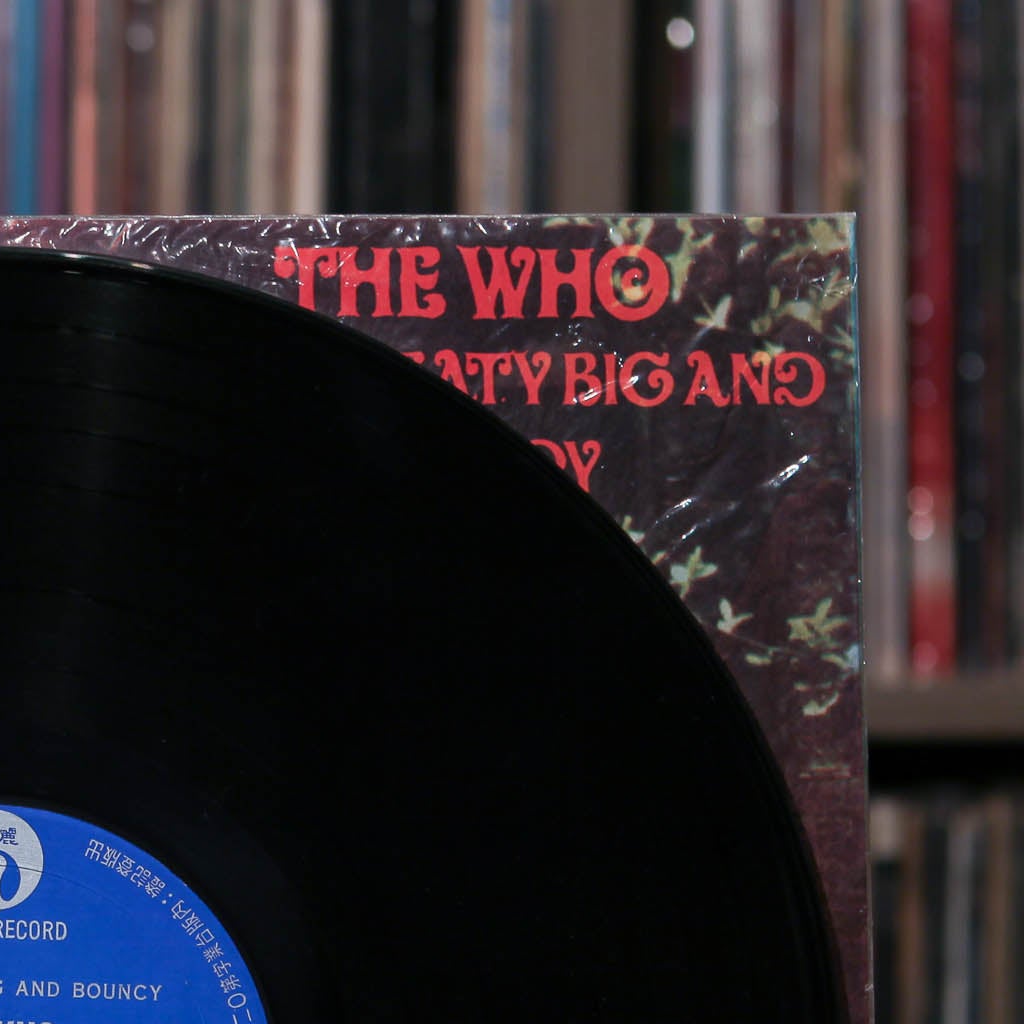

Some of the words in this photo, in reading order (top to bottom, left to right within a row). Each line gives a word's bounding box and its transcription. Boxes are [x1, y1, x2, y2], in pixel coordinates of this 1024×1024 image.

[275, 245, 446, 320] THE
[456, 244, 671, 321] WHO
[400, 350, 553, 406] ATY
[562, 350, 674, 407] BIG
[683, 349, 826, 407] AND
[15, 980, 60, 997] AND
[72, 982, 162, 1001] BOUNCY
